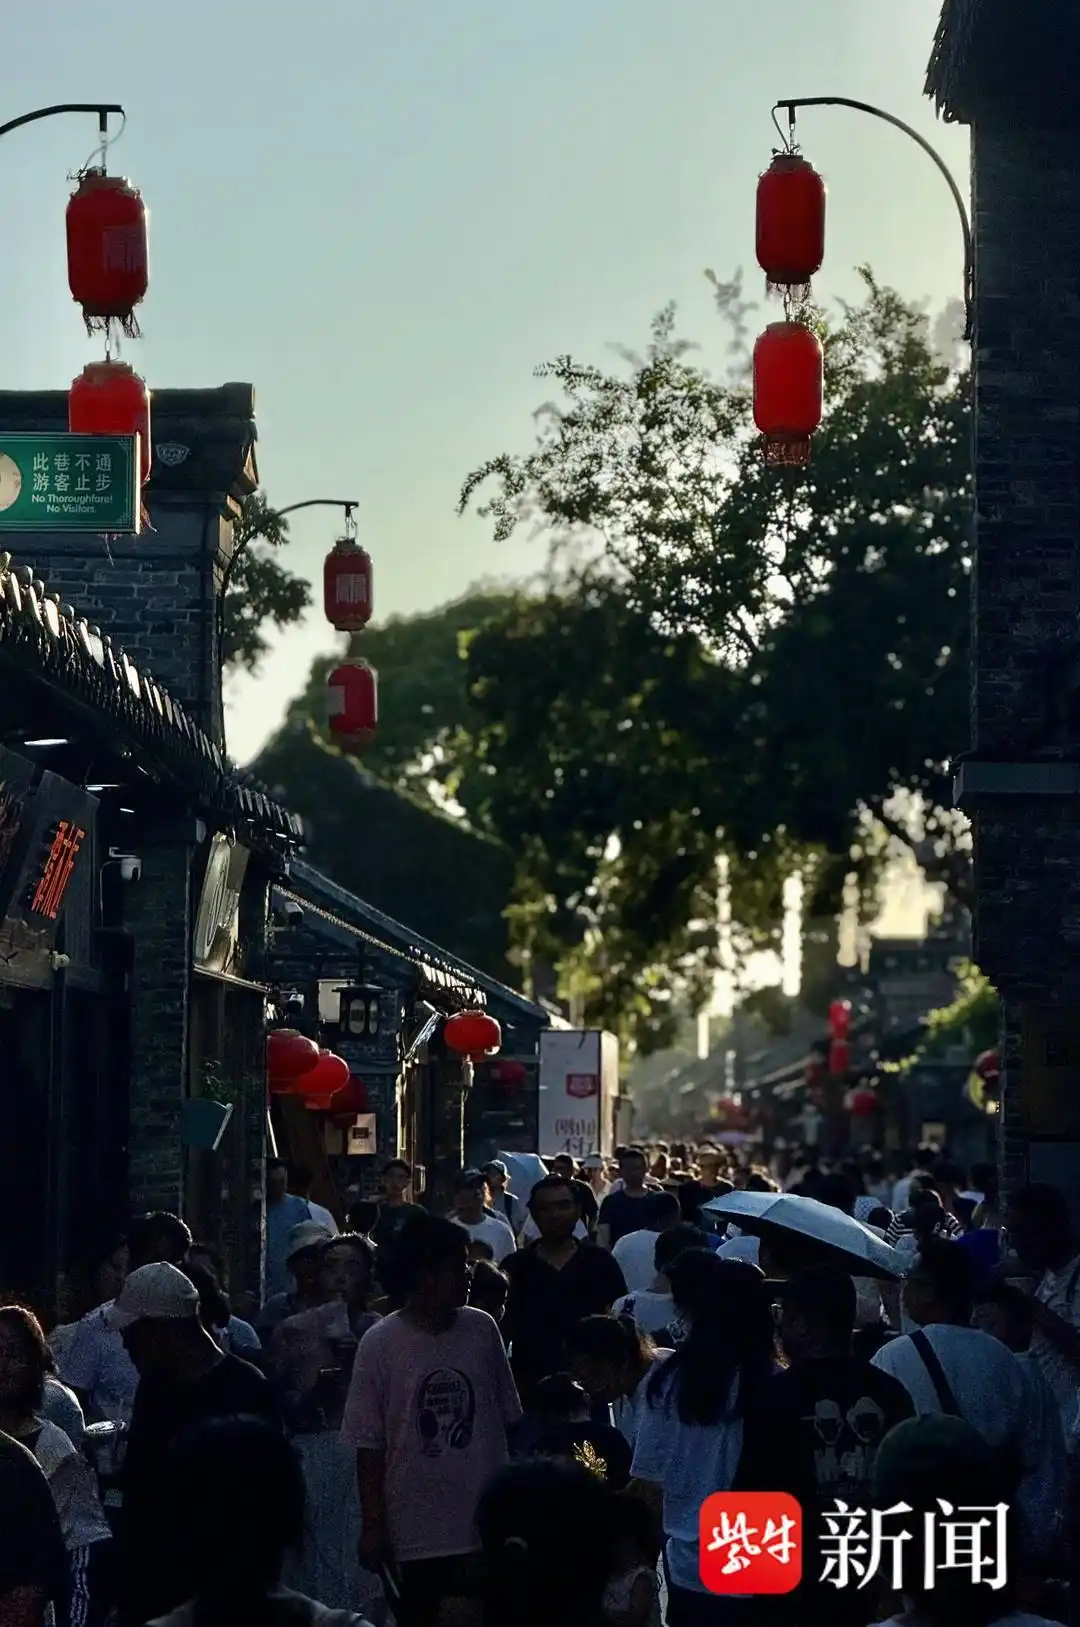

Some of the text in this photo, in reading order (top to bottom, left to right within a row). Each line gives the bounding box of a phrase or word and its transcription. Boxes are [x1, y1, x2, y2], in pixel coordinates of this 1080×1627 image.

[33, 452, 112, 472] 此巷不通
[33, 473, 112, 492] 游客止步
[32, 494, 46, 503] No
[46, 504, 60, 513] No
